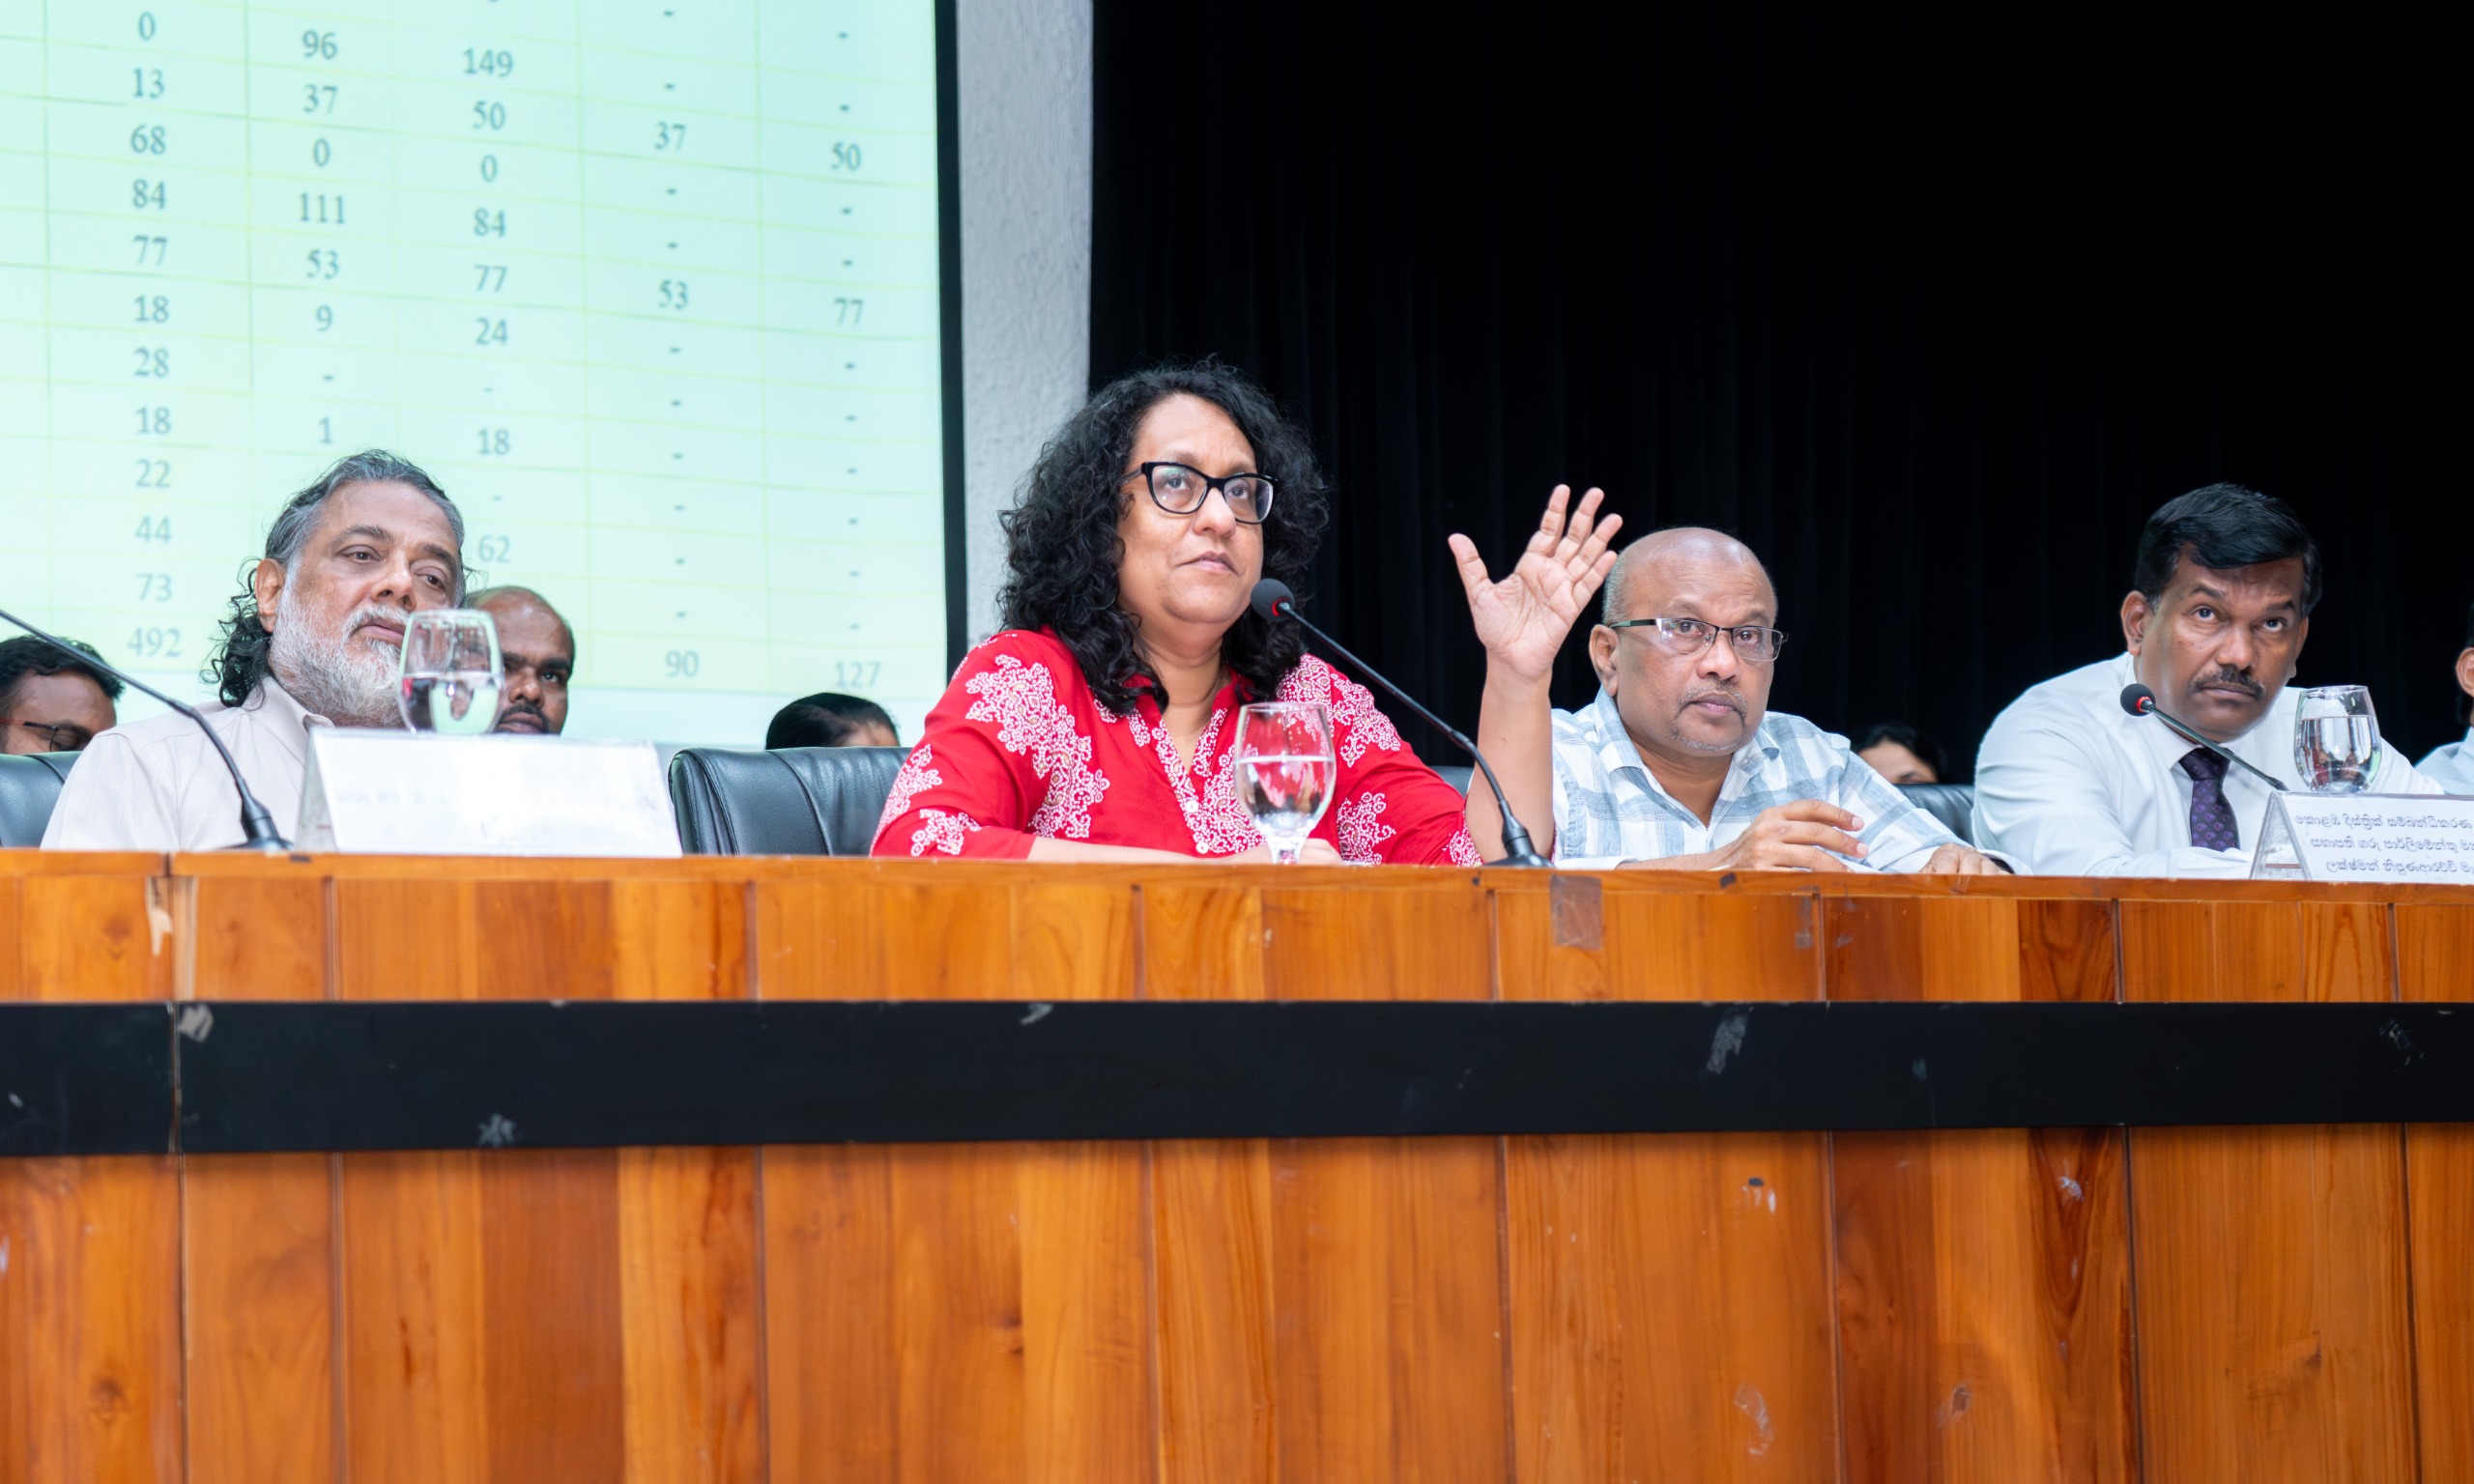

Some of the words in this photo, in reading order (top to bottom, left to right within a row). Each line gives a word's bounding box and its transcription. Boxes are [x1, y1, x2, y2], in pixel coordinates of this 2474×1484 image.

[137, 11, 157, 42] 0
[302, 29, 338, 61] 96
[463, 46, 514, 78] 149
[133, 67, 165, 100] 13
[302, 83, 339, 114] 37
[473, 100, 506, 131] 50
[654, 121, 687, 152] 37
[830, 141, 862, 172] 50
[129, 124, 167, 156] 68
[312, 137, 331, 169] 0
[480, 154, 499, 184] 0
[131, 178, 167, 211] 84
[299, 192, 346, 225] 111
[474, 208, 507, 239] 84
[132, 234, 169, 267] 77
[305, 248, 340, 280] 53
[475, 264, 508, 294] 77
[658, 278, 689, 310] 53
[833, 297, 865, 327] 77
[133, 294, 170, 325] 18
[315, 304, 334, 333] 9
[475, 316, 509, 346] 24
[133, 346, 170, 379] 28
[135, 406, 172, 435] 18
[317, 416, 333, 445] 1
[477, 427, 511, 456] 18
[135, 458, 172, 489] 22
[134, 515, 172, 545] 44
[478, 534, 511, 564] 62
[135, 572, 173, 603] 73
[128, 626, 183, 657] 492
[666, 649, 700, 677] 90
[834, 661, 881, 688] 127
[2358, 838, 2381, 851] ගරු
